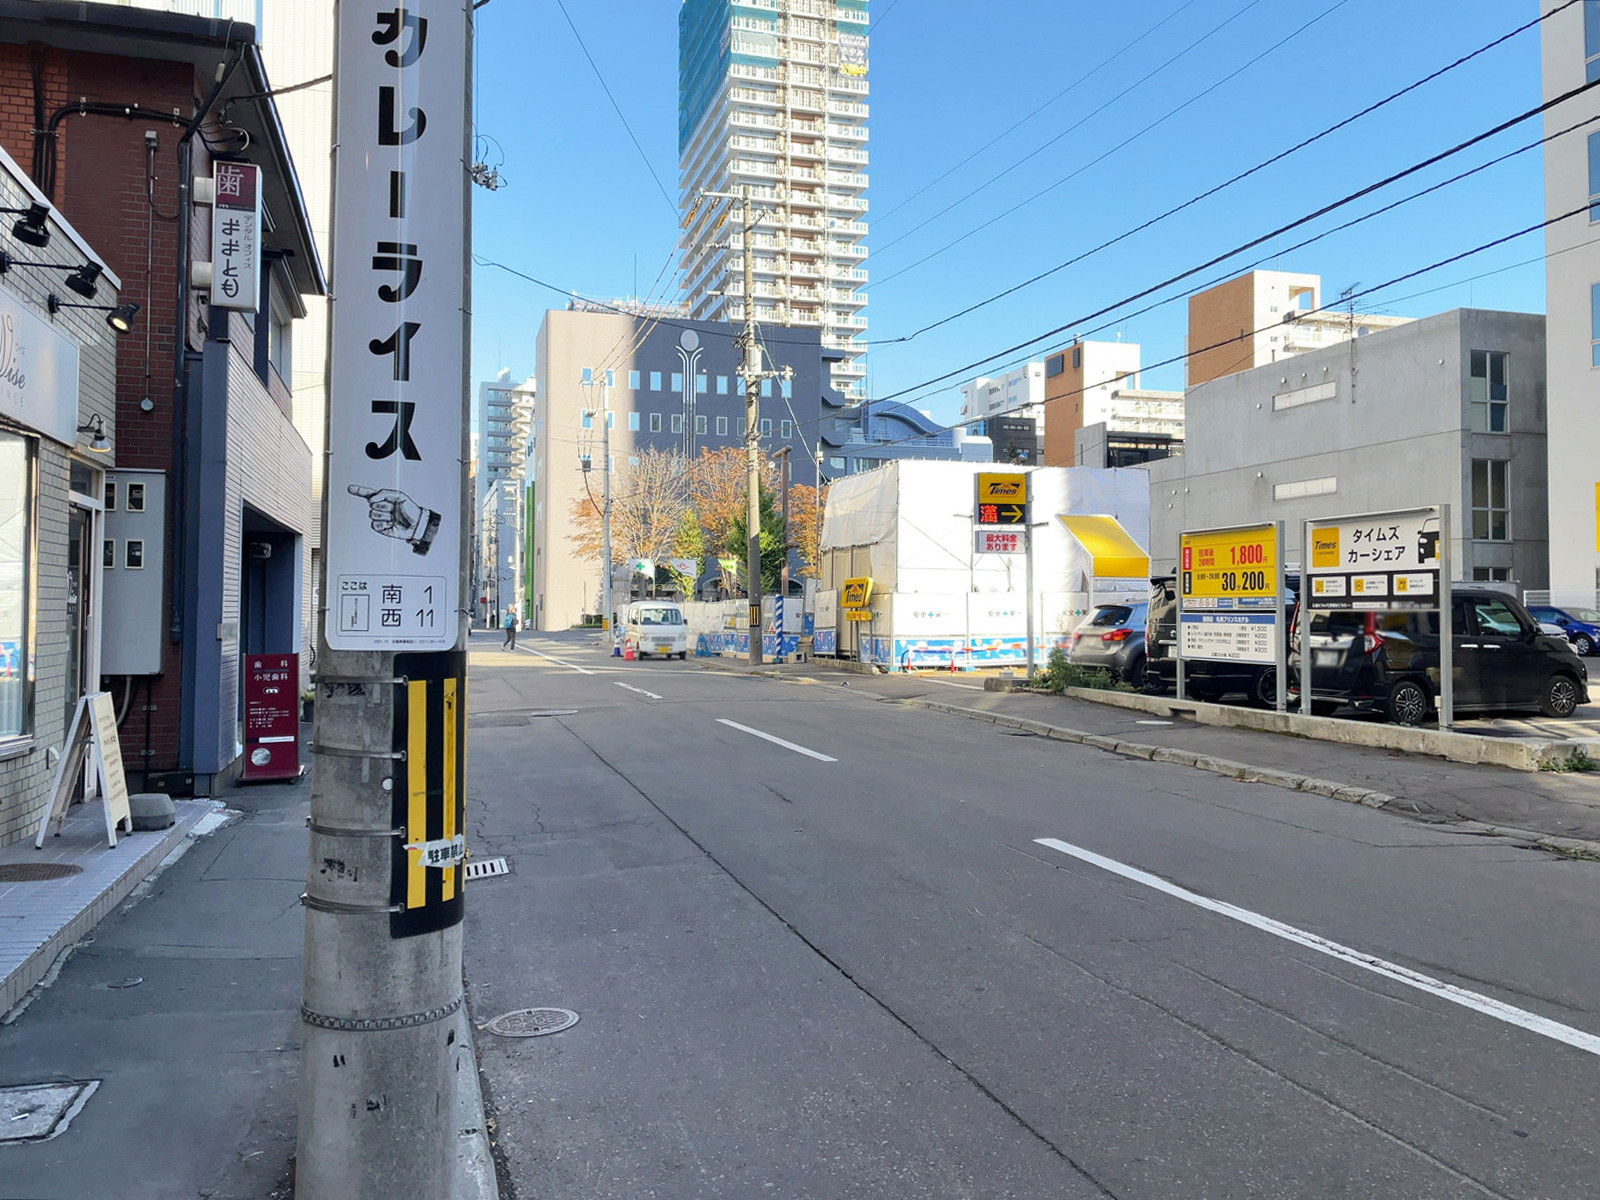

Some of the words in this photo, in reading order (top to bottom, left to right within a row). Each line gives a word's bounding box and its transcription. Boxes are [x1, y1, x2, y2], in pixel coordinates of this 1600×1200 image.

[216, 165, 244, 197] 歯
[365, 7, 428, 461] カレーライス
[988, 483, 1020, 495] Times
[981, 505, 997, 523] 満
[986, 534, 1017, 542] 最大料金
[1353, 526, 1400, 543] タイムズ
[986, 543, 1017, 551] あります
[1315, 540, 1336, 550] Times
[1348, 546, 1406, 563] カーシェア
[342, 581, 368, 590] ここは
[382, 584, 402, 604] 南
[424, 585, 432, 604] 1
[381, 608, 402, 627] 西
[416, 609, 434, 627] 11
[254, 673, 289, 681] 小児歯科
